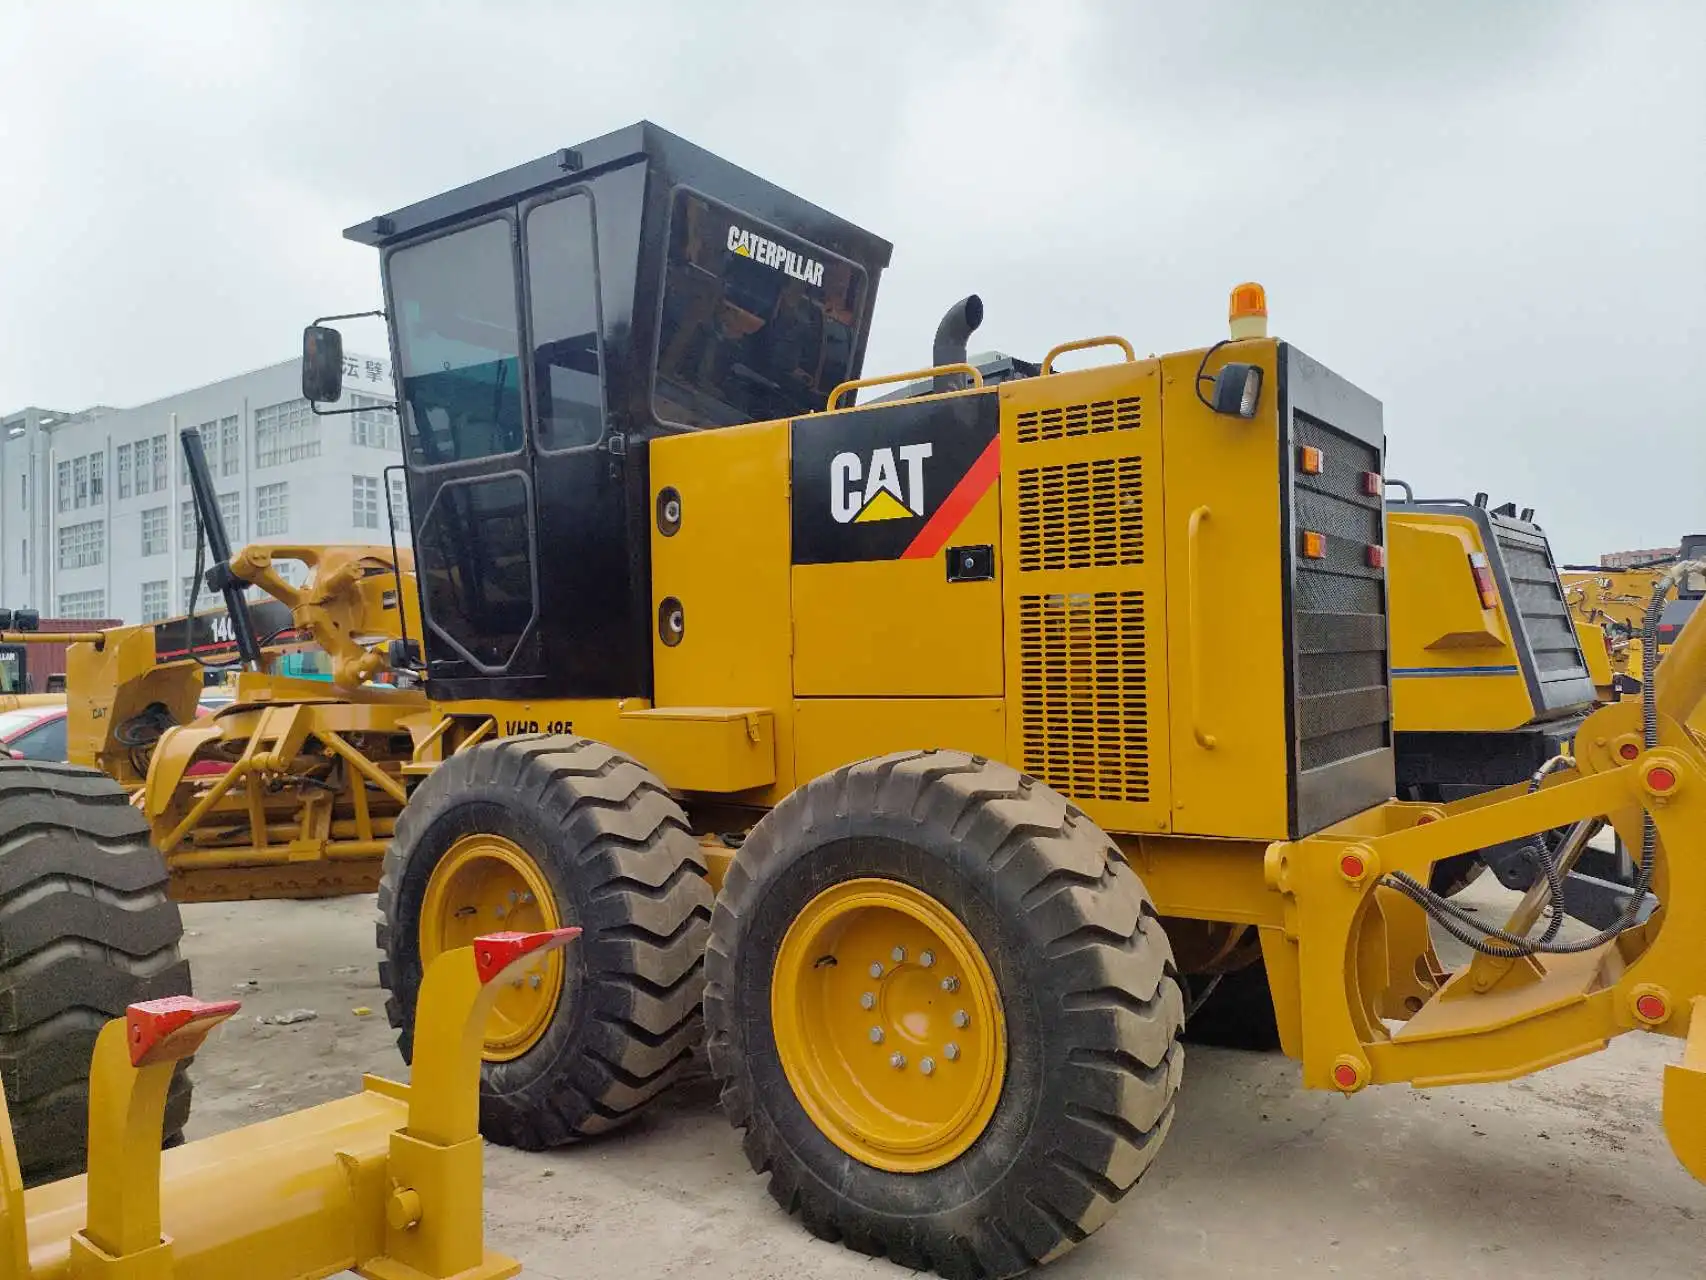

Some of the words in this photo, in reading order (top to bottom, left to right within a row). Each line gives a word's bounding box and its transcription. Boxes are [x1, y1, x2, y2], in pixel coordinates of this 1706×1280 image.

[726, 225, 825, 288] CATERPILLAR
[831, 442, 933, 523] CAT
[92, 707, 107, 719] CAT
